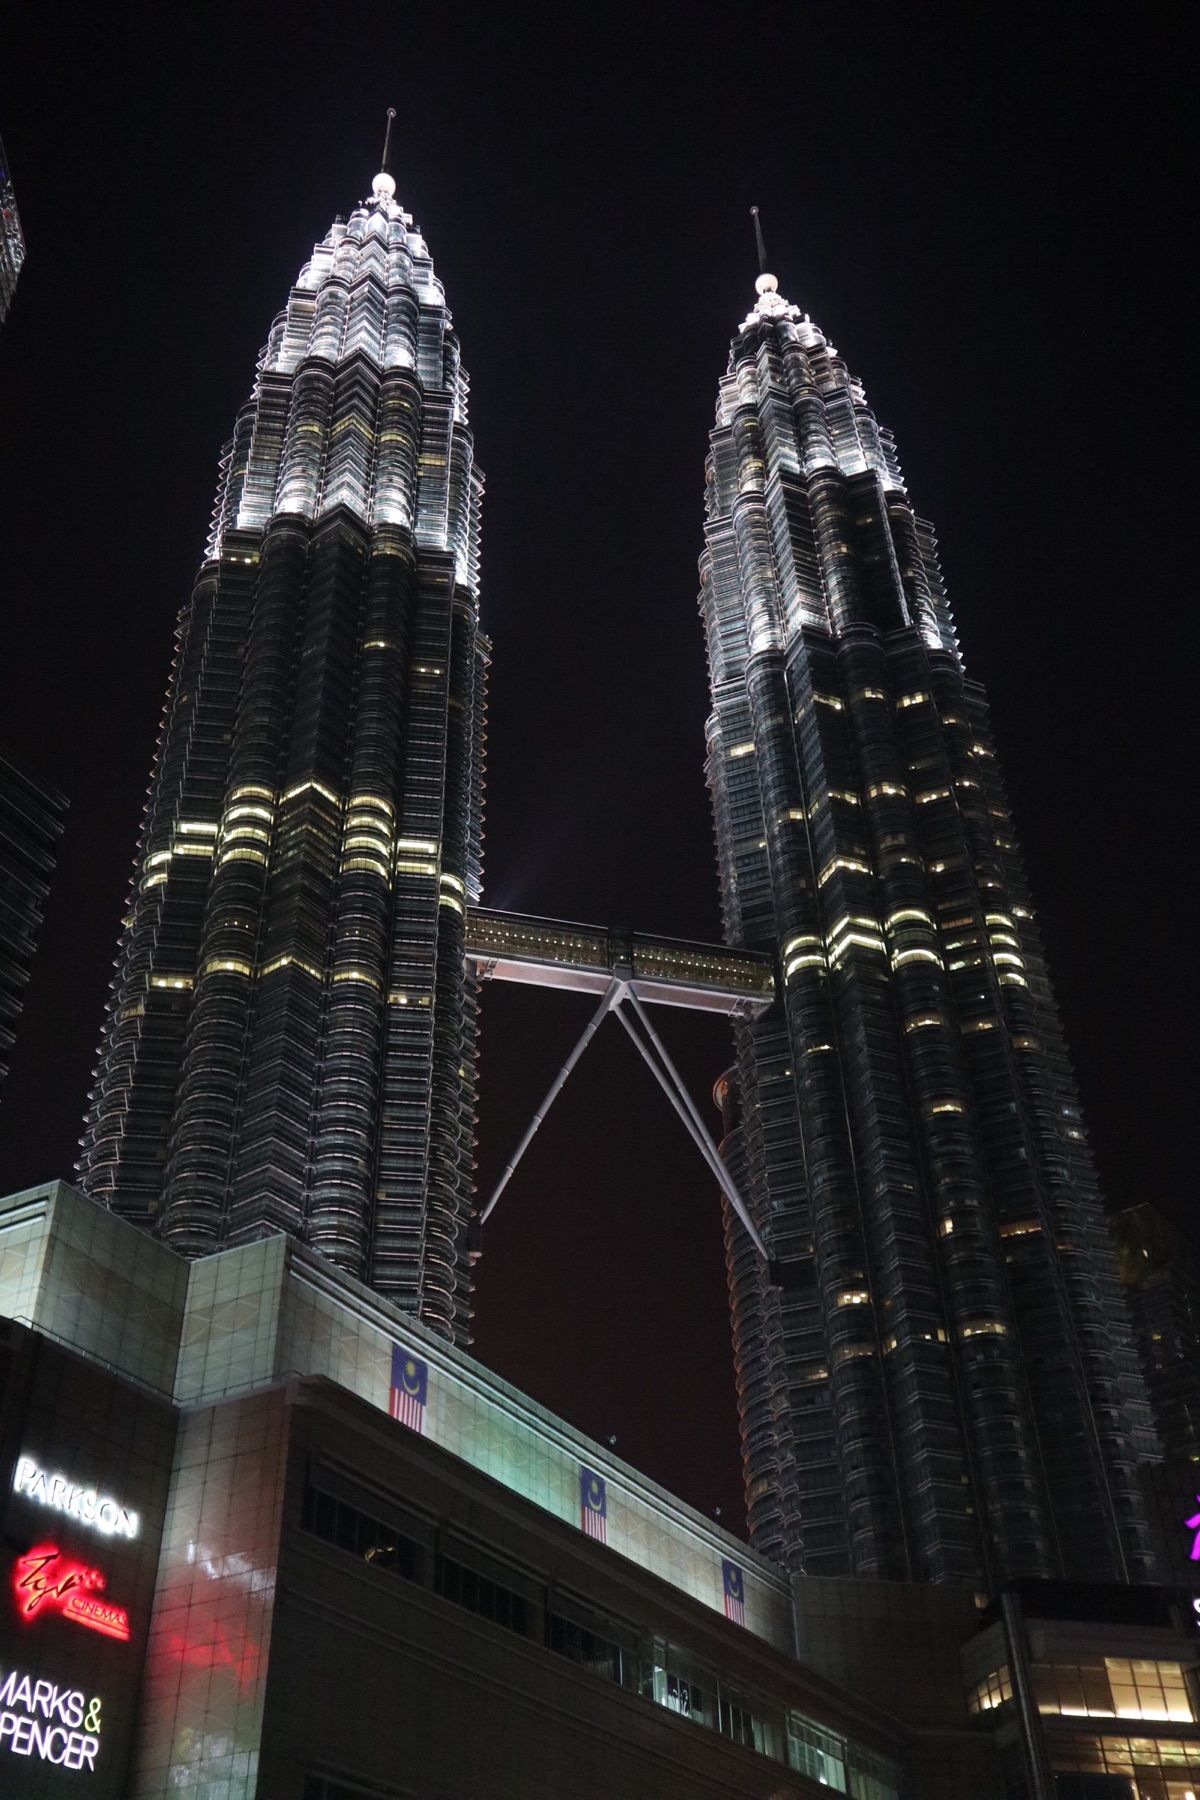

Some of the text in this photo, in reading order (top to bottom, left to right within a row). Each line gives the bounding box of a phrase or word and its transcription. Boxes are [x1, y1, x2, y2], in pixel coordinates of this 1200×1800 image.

[15, 1458, 139, 1538] PARKSON
[71, 1597, 127, 1625] CINEMAS
[84, 1697, 101, 1734] &
[0, 1711, 99, 1772] PENCER
